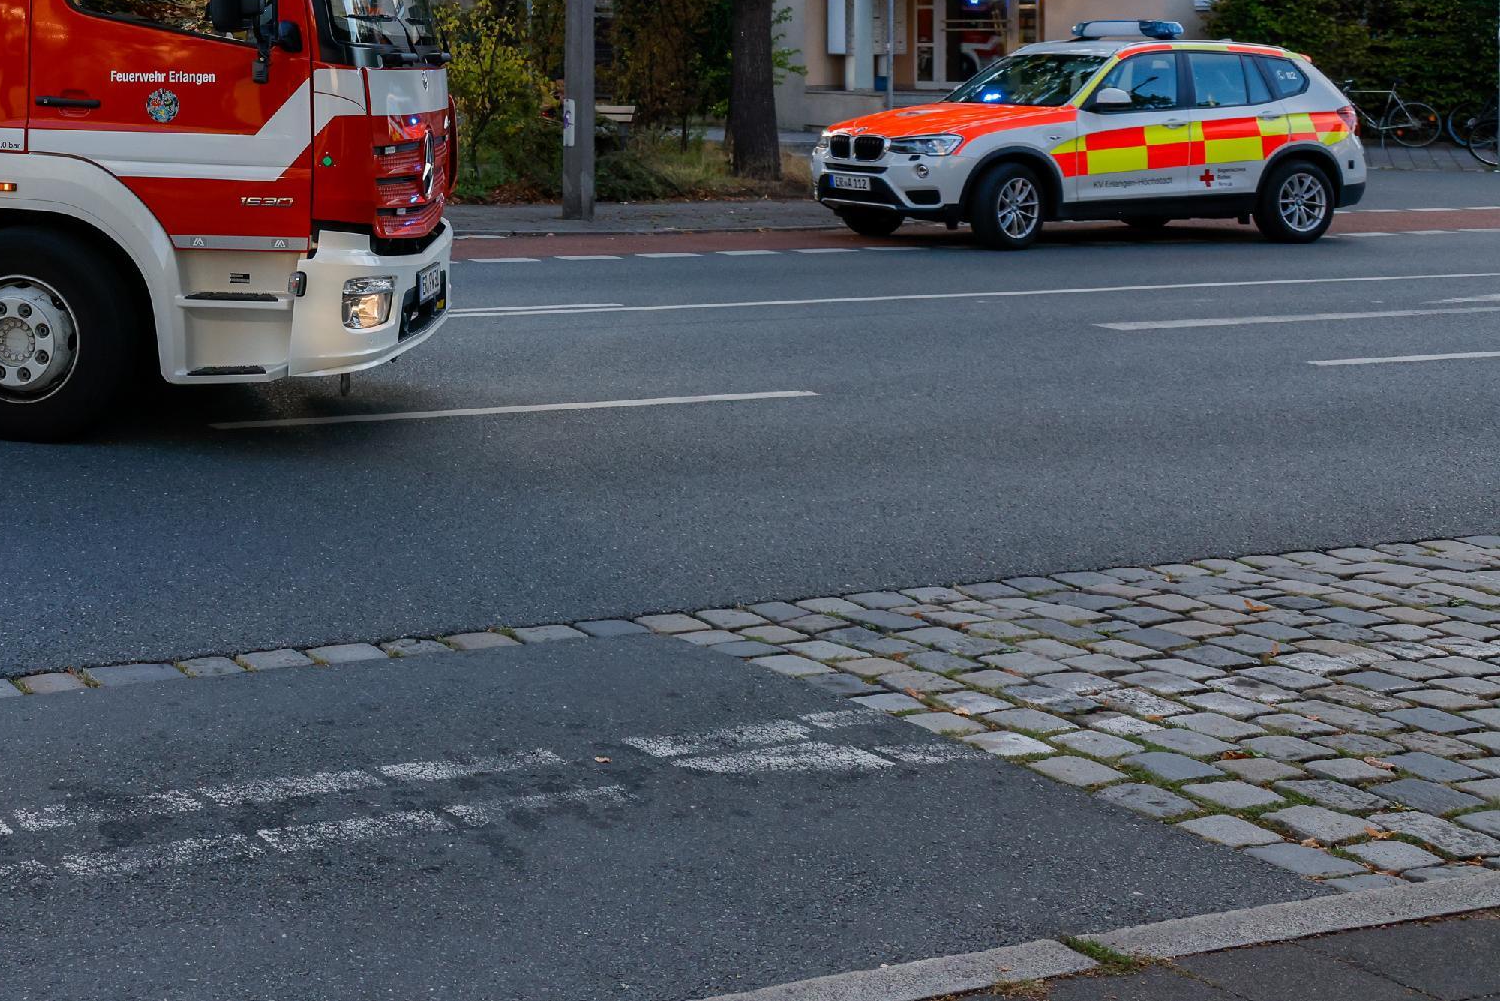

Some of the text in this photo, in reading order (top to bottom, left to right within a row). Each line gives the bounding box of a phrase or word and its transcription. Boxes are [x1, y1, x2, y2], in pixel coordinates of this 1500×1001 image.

[110, 70, 216, 86] Feuerwehr Erlangen
[8, 141, 21, 149] bar
